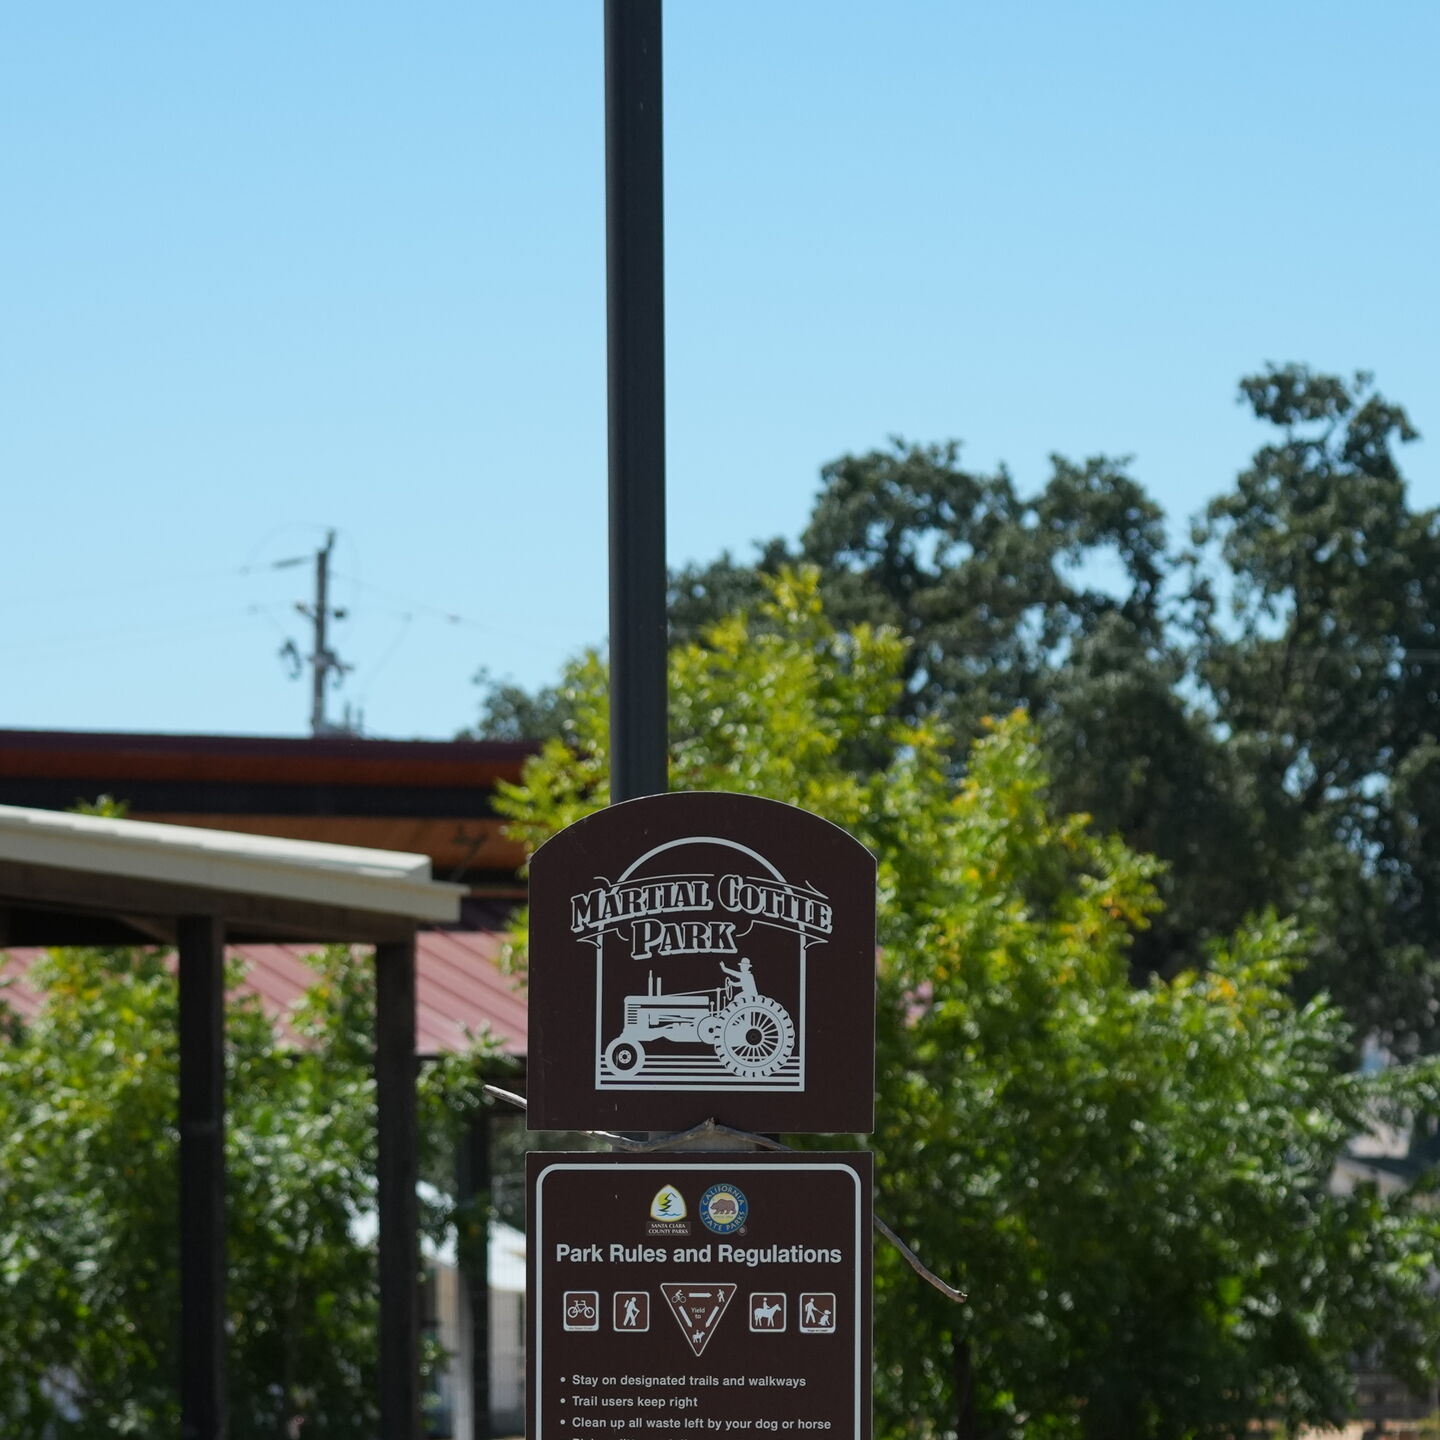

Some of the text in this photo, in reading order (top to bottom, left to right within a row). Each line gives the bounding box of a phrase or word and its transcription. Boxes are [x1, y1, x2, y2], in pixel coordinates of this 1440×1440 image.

[571, 874, 832, 934] MARTIAL COTTLE
[631, 918, 738, 960] PARK
[702, 1185, 745, 1206] CALIFORNIA
[702, 1211, 745, 1231] STATE PARKS
[557, 1244, 841, 1267] Park Rules and Regulations
[691, 1306, 706, 1314] Yield
[572, 1374, 806, 1389] Stay on designated trails and walkways
[571, 1395, 698, 1410] Trail users keep right
[571, 1416, 832, 1432] Clean up all waste left by your dog or horse
